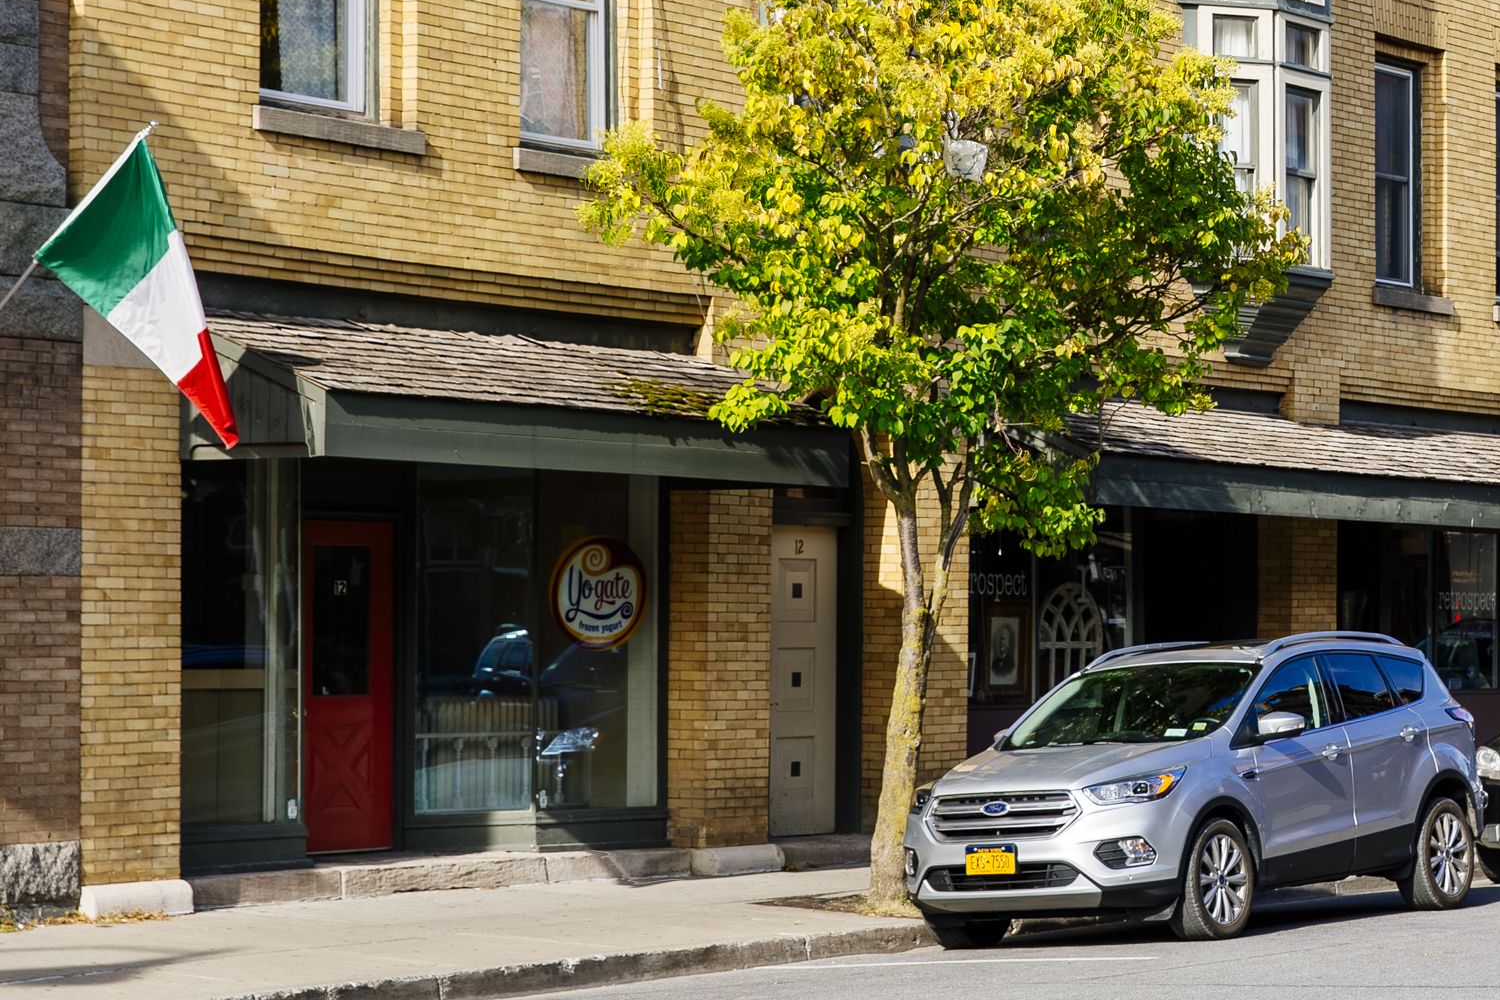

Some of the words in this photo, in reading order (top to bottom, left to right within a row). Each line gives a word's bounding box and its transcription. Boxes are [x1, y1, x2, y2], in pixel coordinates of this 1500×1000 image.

[794, 539, 804, 556] 12
[565, 564, 633, 622] Yogate
[579, 621, 600, 633] frozen
[600, 621, 623, 634] yogurt
